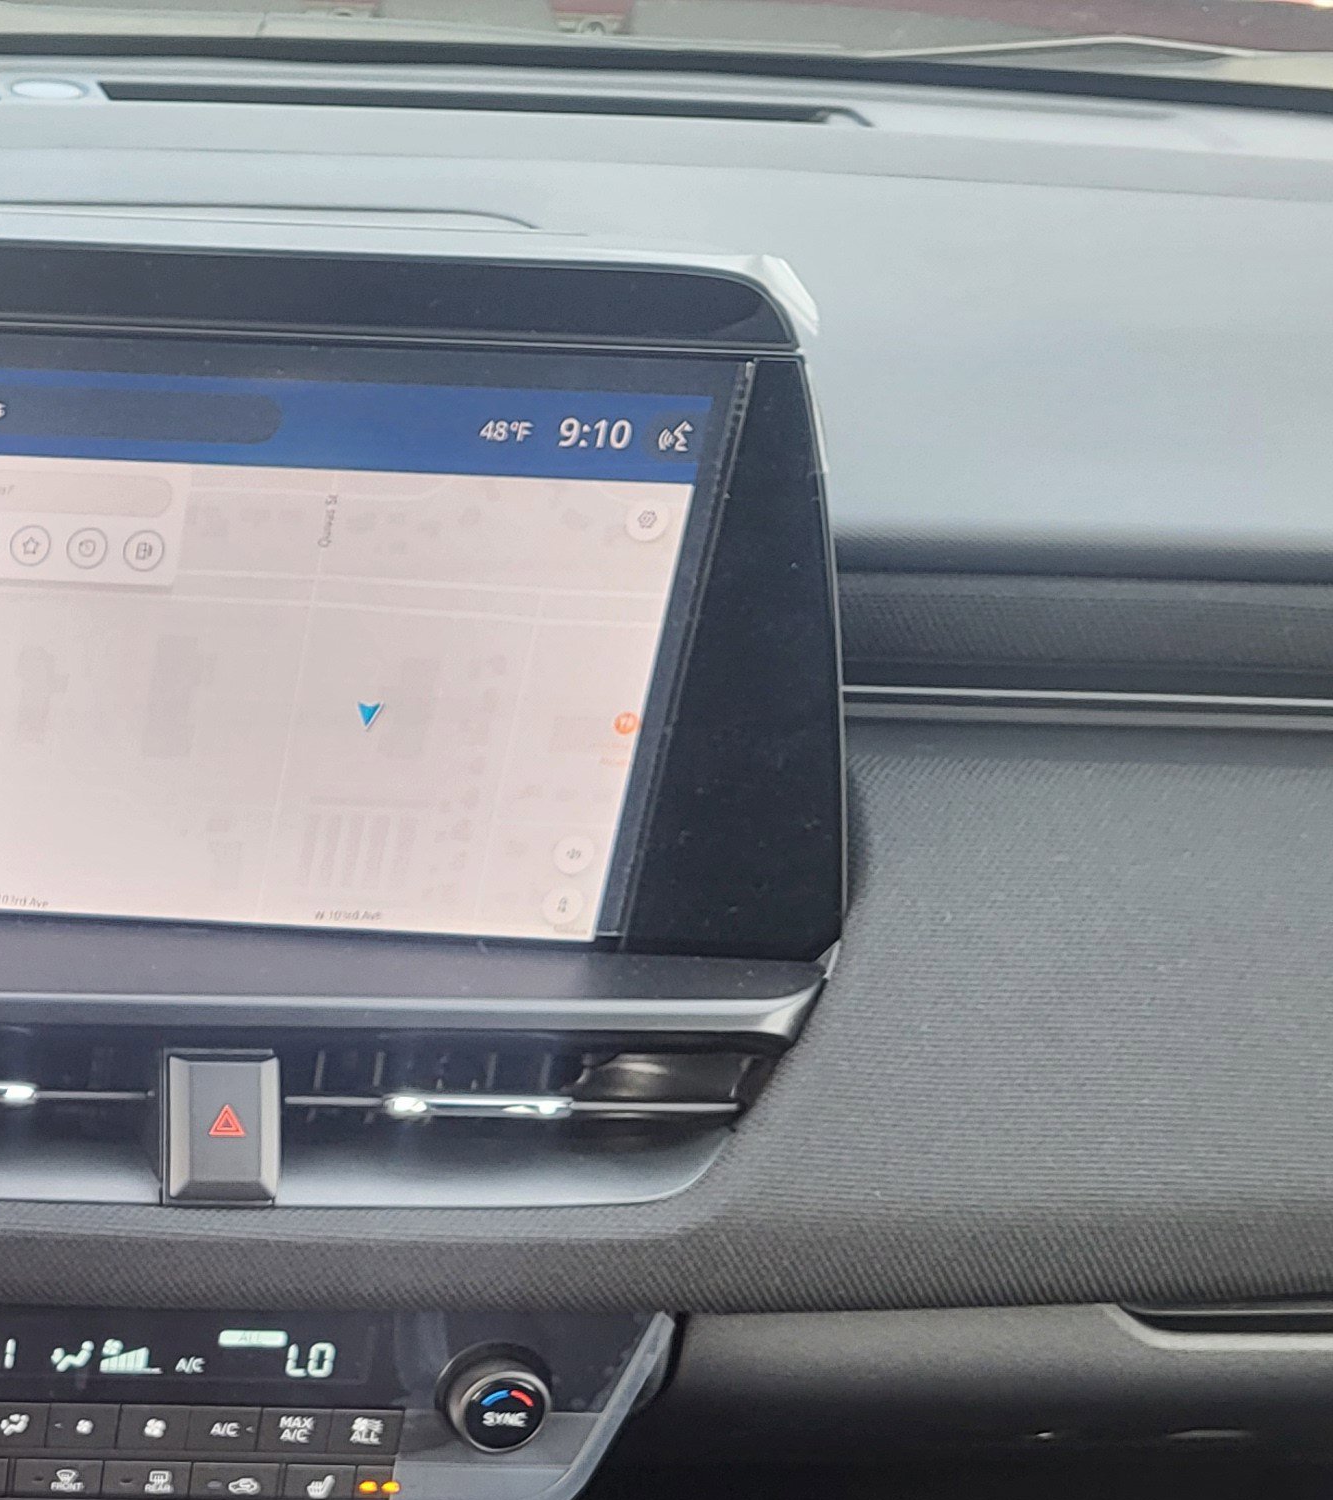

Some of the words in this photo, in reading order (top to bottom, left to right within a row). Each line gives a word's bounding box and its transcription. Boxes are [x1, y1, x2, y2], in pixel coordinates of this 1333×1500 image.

[479, 418, 534, 443] 48°F
[558, 416, 634, 450] 9:10
[175, 1356, 206, 1373] A/C
[279, 1416, 314, 1430] MAX
[482, 1411, 528, 1427] SYNC
[210, 1421, 241, 1437] A/C
[279, 1429, 311, 1444] A/C
[350, 1430, 382, 1446] ALL
[50, 1480, 84, 1492] FRONT
[144, 1482, 174, 1494] REAR
